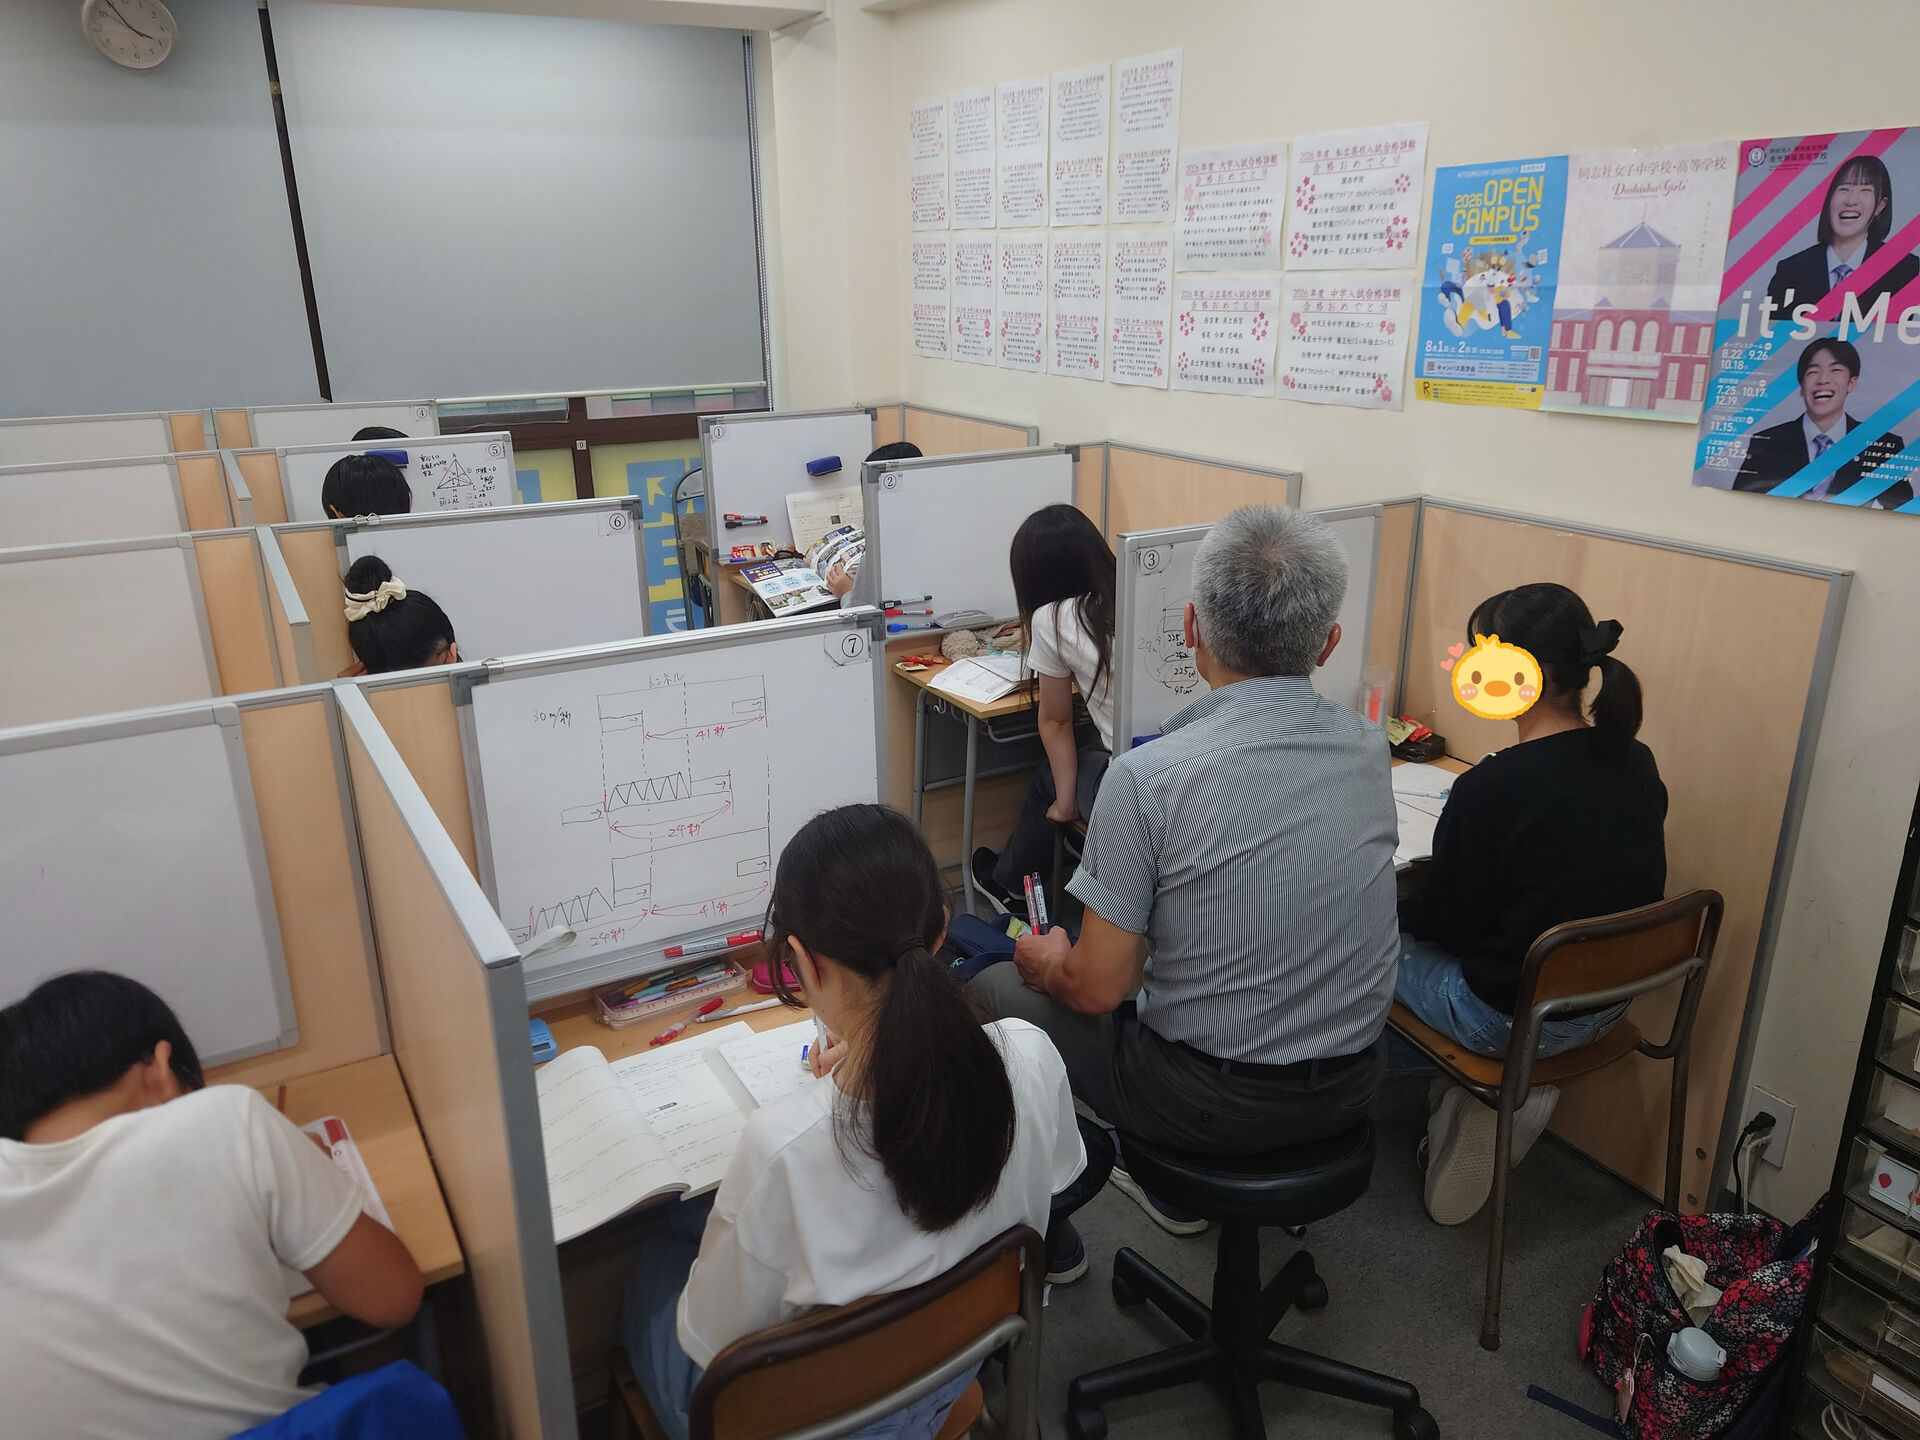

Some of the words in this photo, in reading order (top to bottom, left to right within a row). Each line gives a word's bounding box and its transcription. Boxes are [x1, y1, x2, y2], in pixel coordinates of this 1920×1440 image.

[1578, 157, 1727, 180] 同志社女子中学校・高等学校
[1454, 193, 1483, 208] 2026
[1484, 175, 1545, 206] OPEN
[1452, 204, 1541, 235] CAMPUS
[1737, 288, 1819, 341] it's
[1837, 291, 1920, 345] Me
[1722, 349, 1743, 359] 8.22
[1748, 350, 1768, 361] 9.26
[1721, 359, 1745, 370] 10.18
[1716, 385, 1737, 395] 7.25
[1743, 387, 1766, 398] 10.17
[1715, 396, 1738, 406] 12.19
[1710, 421, 1733, 432] 11.15
[695, 725, 725, 740] 41秒
